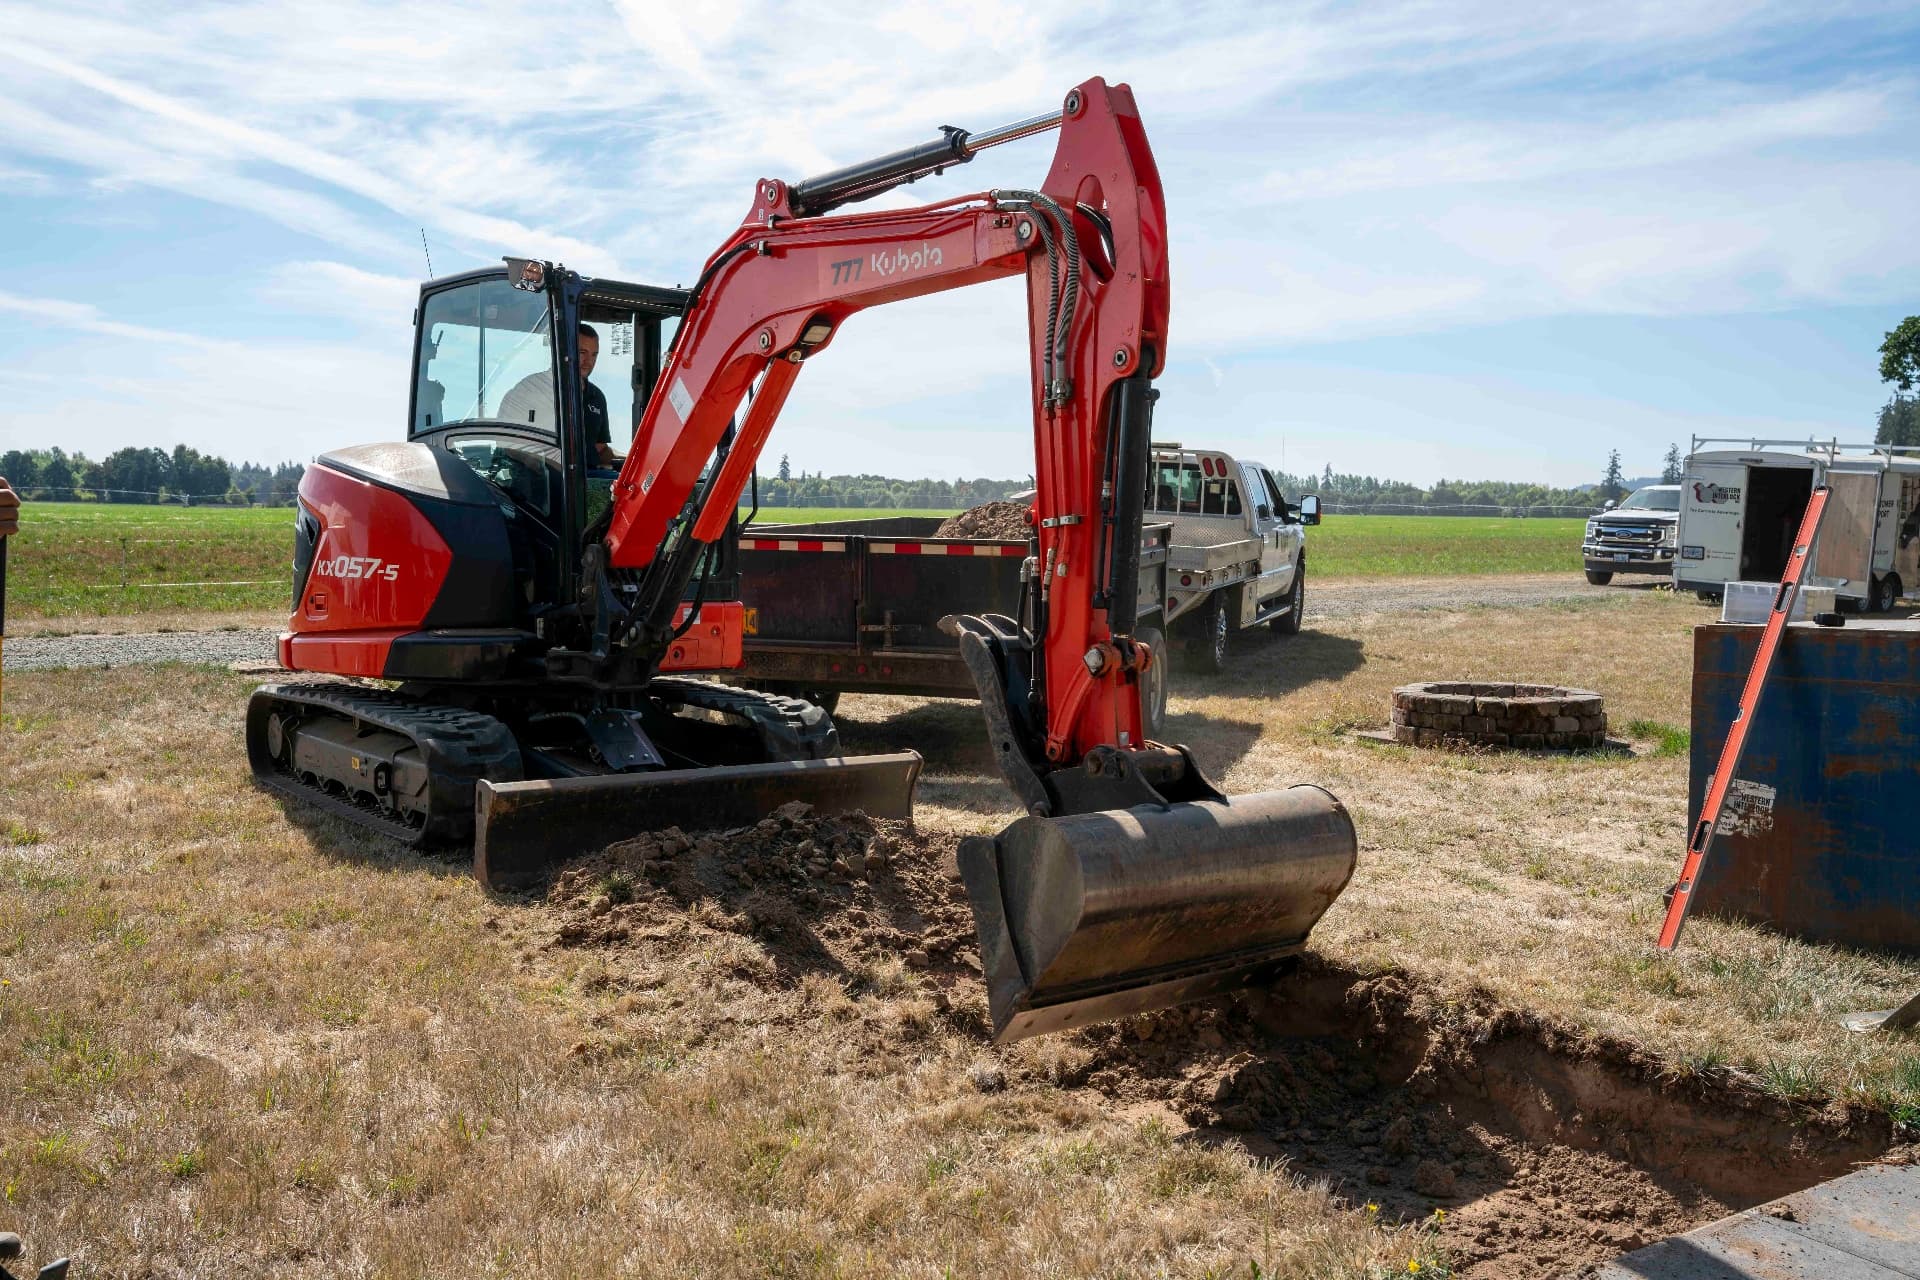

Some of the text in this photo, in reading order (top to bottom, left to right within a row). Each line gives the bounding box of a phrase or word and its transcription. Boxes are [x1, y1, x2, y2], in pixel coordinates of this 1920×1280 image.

[871, 241, 942, 276] Kubota
[317, 555, 400, 581] KX057-5
[1733, 800, 1770, 815] INTOCK
[1741, 793, 1771, 807] WESTERN
